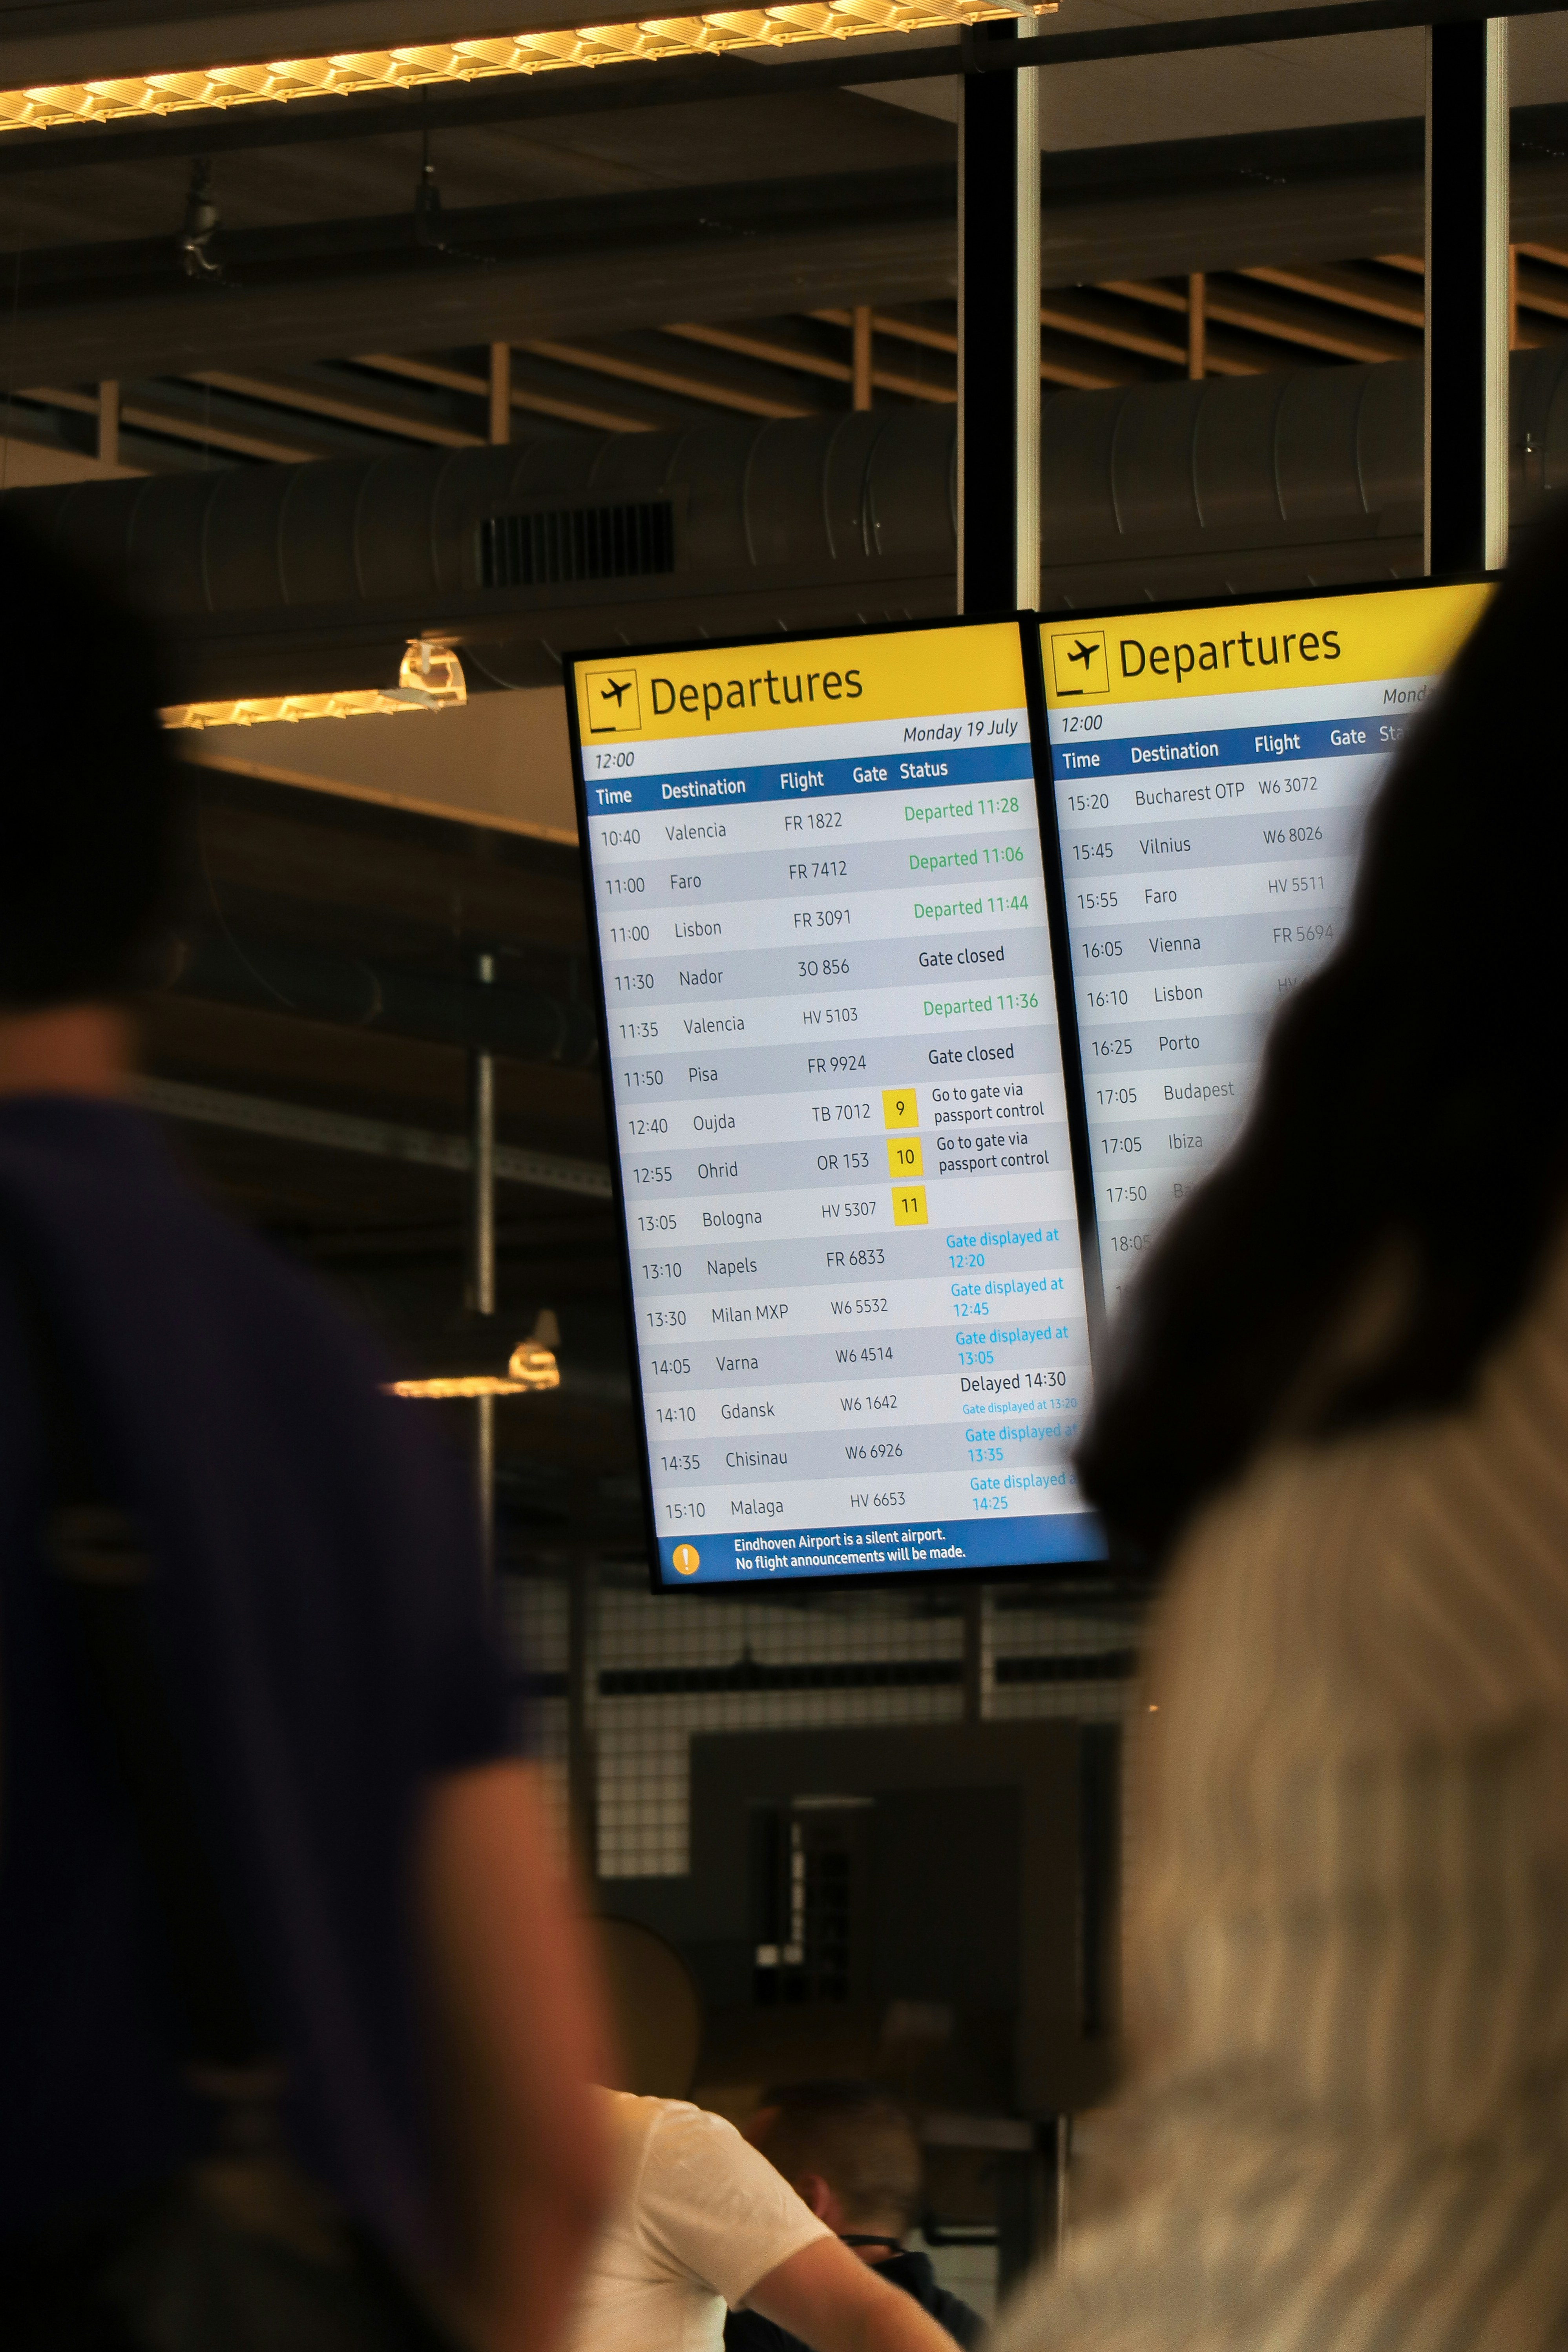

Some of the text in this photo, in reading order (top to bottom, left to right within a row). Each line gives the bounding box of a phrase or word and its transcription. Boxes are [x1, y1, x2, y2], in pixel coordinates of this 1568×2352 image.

[1120, 630, 1341, 683] Departures
[651, 670, 863, 721] Departures
[904, 718, 1018, 742] Monday 19 July
[1062, 715, 1102, 732] 12:00
[1254, 733, 1301, 755] Flight
[1330, 729, 1366, 746] Gate
[596, 752, 634, 769] 12:00
[1062, 752, 1100, 769] Time
[1131, 741, 1219, 763] Destination
[853, 766, 887, 783] Gate
[900, 761, 948, 779] Status
[662, 778, 746, 800] Destination
[780, 770, 824, 792] Flight
[1258, 777, 1317, 794] W6 3072
[596, 788, 632, 805] Time
[1135, 782, 1244, 805] Bucharest OTP
[905, 797, 1019, 823] Departed 11:28
[1068, 794, 1108, 811] 15:20
[785, 812, 842, 831] FR 1822
[601, 829, 640, 846] 10:40
[665, 823, 726, 841] Valencia
[1263, 827, 1322, 844] W6 8026
[1073, 843, 1113, 860] 15:45
[1139, 836, 1190, 854] Vilnius
[909, 847, 1024, 872] Departed 11:06
[789, 861, 847, 879] FR 7412
[606, 878, 644, 894] 11:00
[670, 875, 701, 889] Faro
[1078, 892, 1117, 909] 15:55
[1145, 889, 1177, 904] Faro
[914, 895, 1028, 920] Departed 11:44
[794, 909, 850, 928] FR 3091
[610, 926, 649, 942] 11:00
[675, 921, 721, 937] Lisbon
[1082, 941, 1122, 958] 16:05
[1149, 937, 1200, 953] Vienna
[919, 946, 1004, 967] Gate closed
[823, 959, 849, 975] 856
[615, 974, 653, 990] 11:30
[680, 969, 723, 986] Nador
[1087, 990, 1127, 1007] 16:10
[1155, 985, 1202, 1002] Lisbon
[924, 993, 1038, 1018] Departed 11:36
[803, 1008, 857, 1024] HV 5103
[619, 1022, 658, 1039] 11:35
[683, 1016, 744, 1034] Valencia
[1092, 1039, 1132, 1055] 16:25
[1159, 1035, 1199, 1051] Porto
[929, 1043, 1014, 1064] Gate closed
[808, 1055, 866, 1073] FR 9924
[624, 1070, 663, 1087] 11:50
[689, 1067, 717, 1082] Pisa
[932, 1083, 1023, 1103] Go to gate via
[1097, 1088, 1137, 1105] 17:05
[1164, 1082, 1234, 1101] Budapest
[812, 1104, 871, 1121] TB 7012
[896, 1101, 904, 1115] 9
[935, 1101, 1044, 1126] passport control
[629, 1119, 668, 1135] 12:40
[694, 1114, 735, 1133] Oujda
[937, 1131, 1028, 1151] Go to gate via
[1102, 1137, 1142, 1154] 17:05
[818, 1152, 869, 1170] OR 153
[897, 1149, 914, 1164] 10
[939, 1150, 1049, 1175] passport control
[633, 1167, 672, 1183] 12:55
[698, 1161, 737, 1179] Ohrid
[822, 1202, 876, 1218] HV 5307
[902, 1198, 917, 1213] 11
[638, 1215, 676, 1231] 13:05
[703, 1211, 761, 1229] Bologna
[946, 1228, 1059, 1248] Gate displayed at
[827, 1249, 884, 1267] FR 6833
[949, 1253, 985, 1268] 12:20
[643, 1263, 681, 1279] 13:10
[708, 1257, 757, 1277] Napels
[951, 1277, 1064, 1297] Gate displayed at
[712, 1304, 788, 1323] Milan MXP
[831, 1298, 888, 1314] W6 5532
[954, 1302, 989, 1317] 12:45
[647, 1311, 686, 1327] 13:30
[956, 1326, 1068, 1345] Gate displayed at
[835, 1347, 893, 1363] W6 4514
[958, 1351, 994, 1365] 13:05
[652, 1359, 690, 1375] 14:05
[716, 1357, 758, 1371] Varna
[961, 1371, 1066, 1393] Delayed 14:30
[721, 1401, 775, 1419] Gdansk
[840, 1395, 897, 1411] W6 1642
[656, 1407, 695, 1423] 14:10
[726, 1450, 787, 1467] Chisinau
[845, 1444, 902, 1459] W6 6926
[661, 1455, 700, 1470] 14:35
[731, 1497, 783, 1517] Malaga
[851, 1492, 905, 1507] HV 6653
[666, 1503, 705, 1518] 15:10
[734, 1528, 946, 1551] Eindhoven Airport is a silent airport.
[736, 1544, 966, 1571] No flight announcements will be made.
